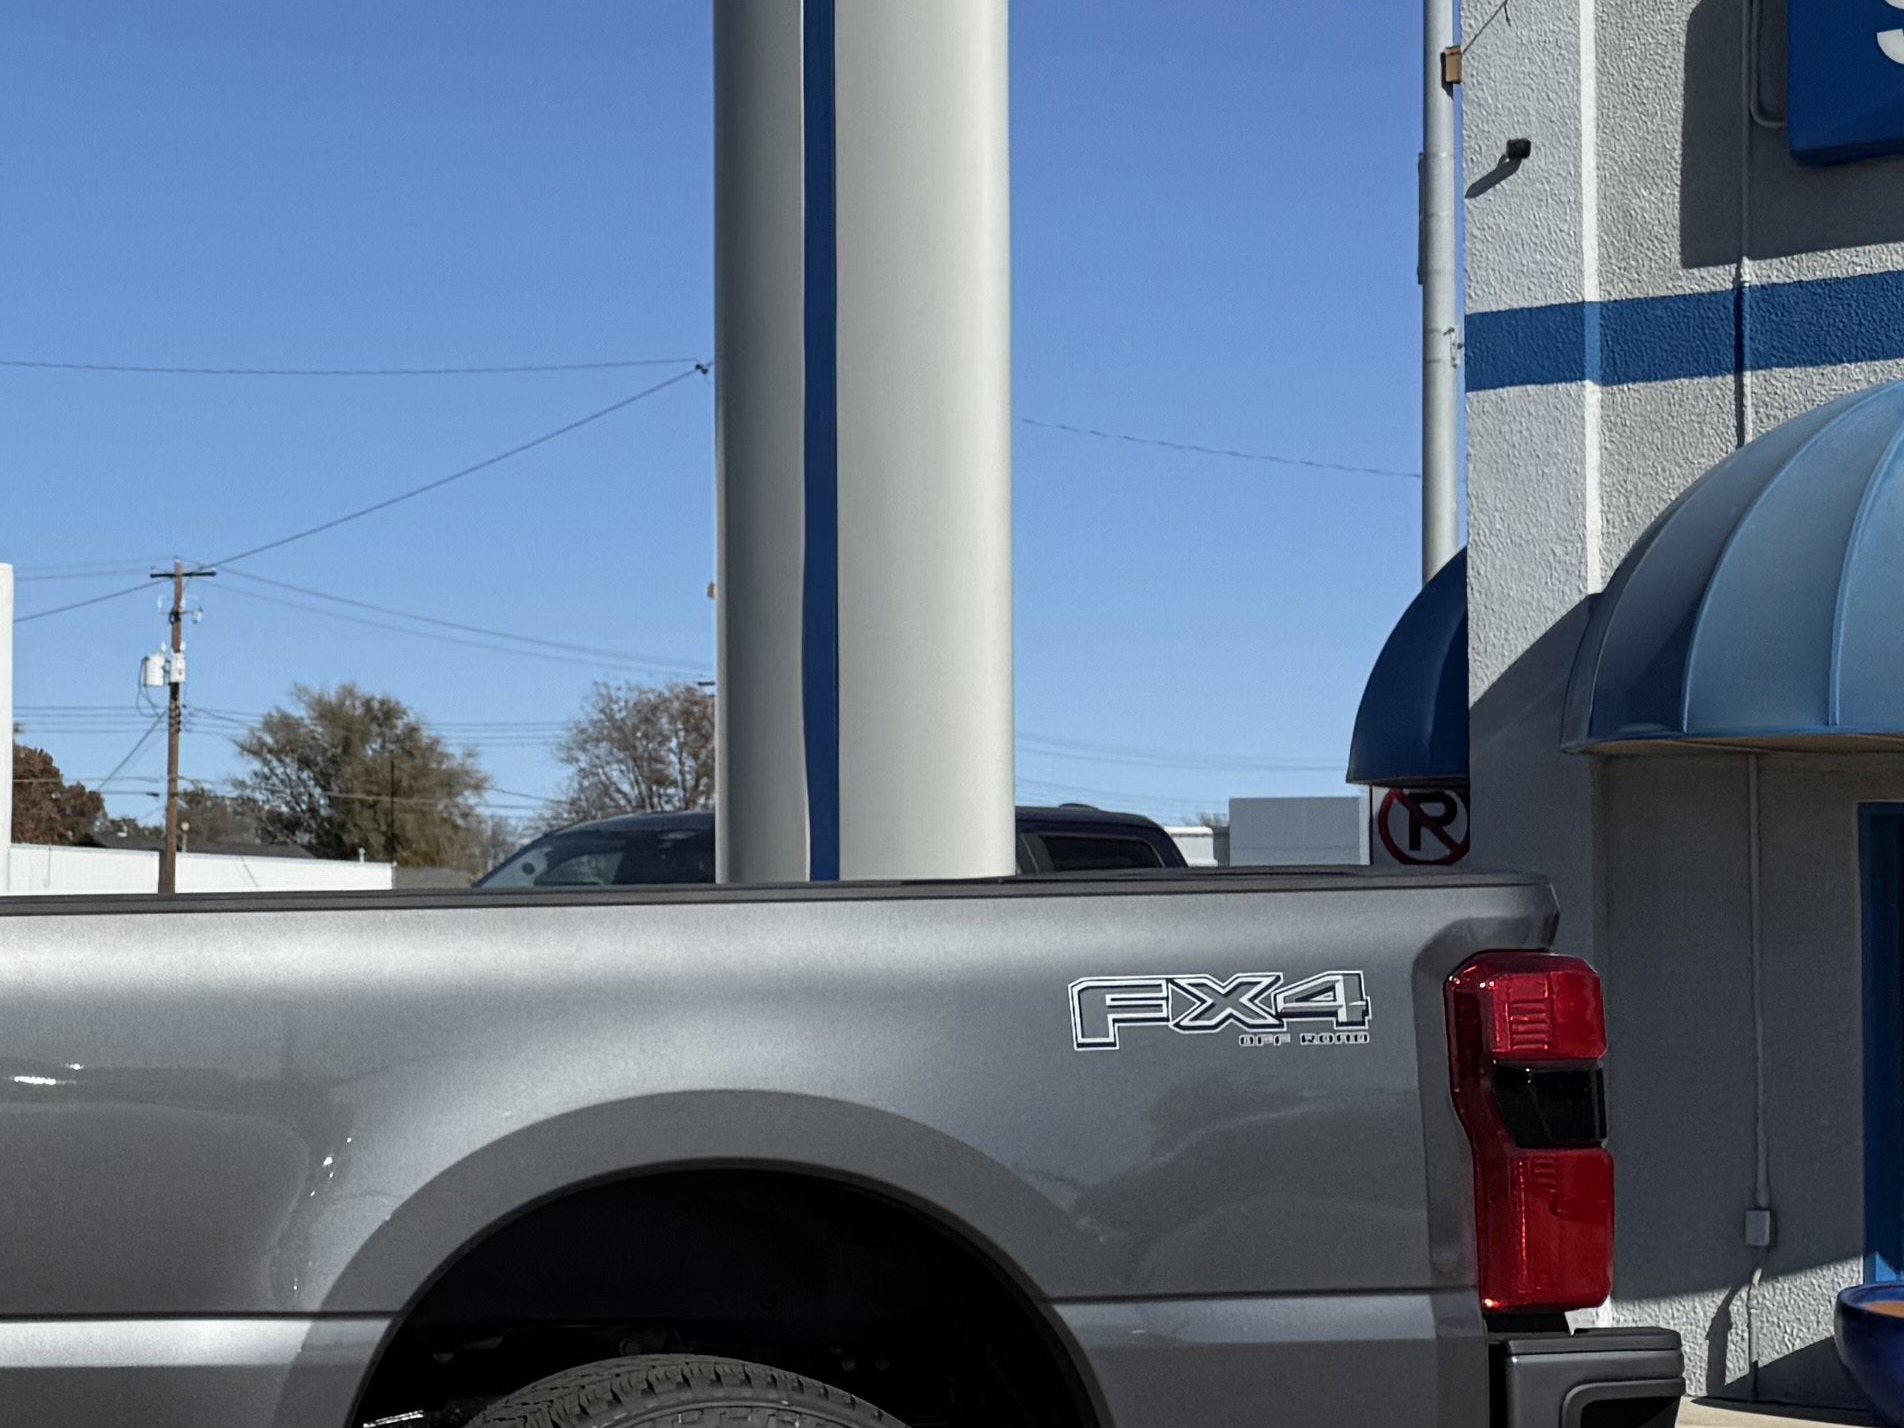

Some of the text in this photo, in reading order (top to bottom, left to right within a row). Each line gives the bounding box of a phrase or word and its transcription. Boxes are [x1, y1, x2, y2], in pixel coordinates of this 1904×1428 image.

[1068, 970, 1372, 1051] FX4
[1238, 1031, 1370, 1047] OFF ROAD
